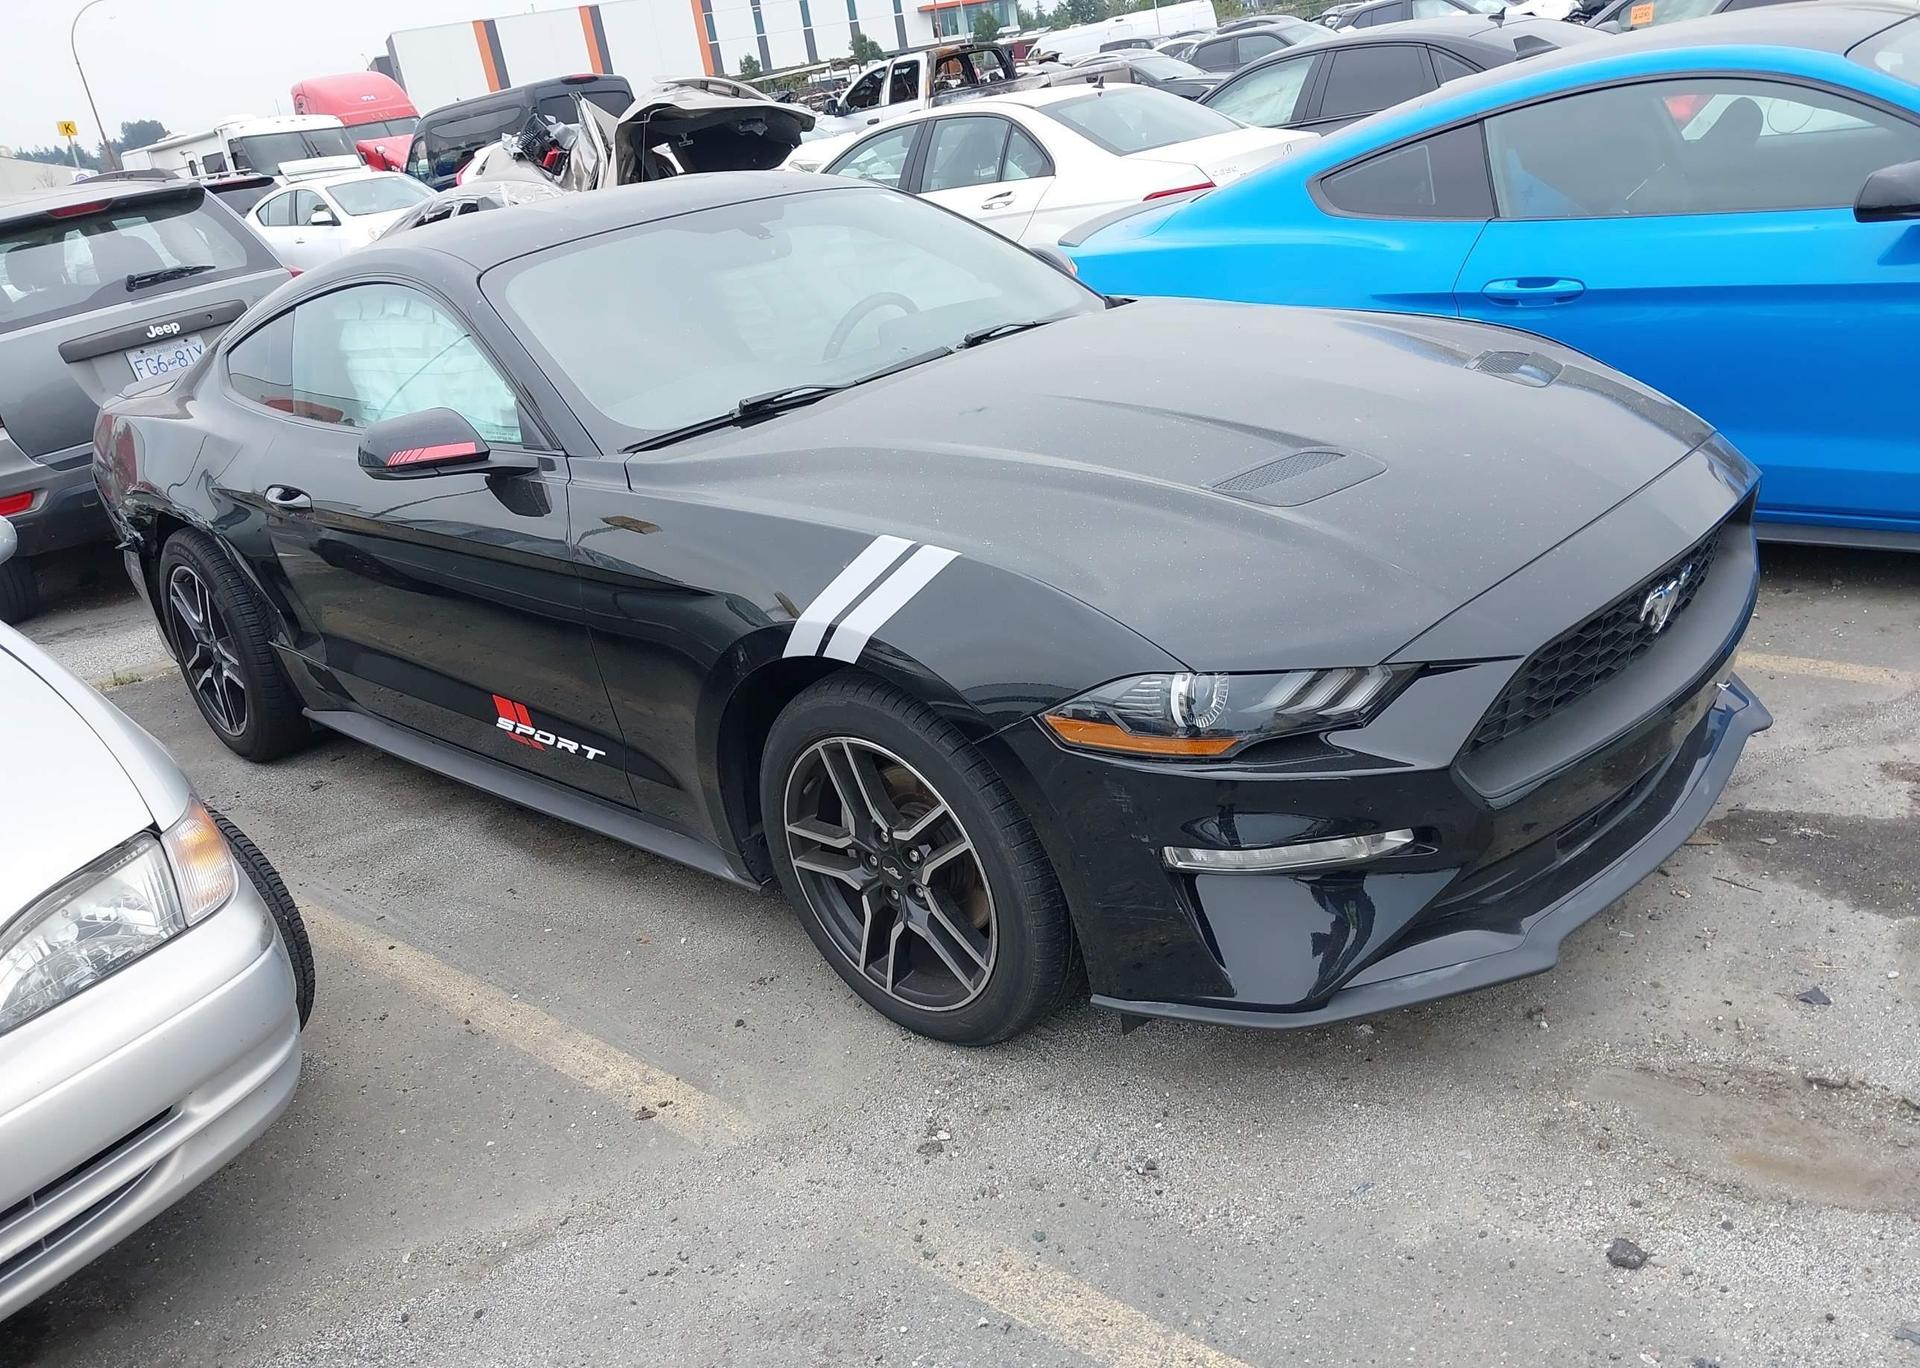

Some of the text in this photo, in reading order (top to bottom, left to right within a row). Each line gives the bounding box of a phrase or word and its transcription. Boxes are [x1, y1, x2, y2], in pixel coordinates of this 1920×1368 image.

[64, 123, 74, 134] K
[146, 322, 181, 338] Jeep
[496, 716, 607, 760] SPORT
